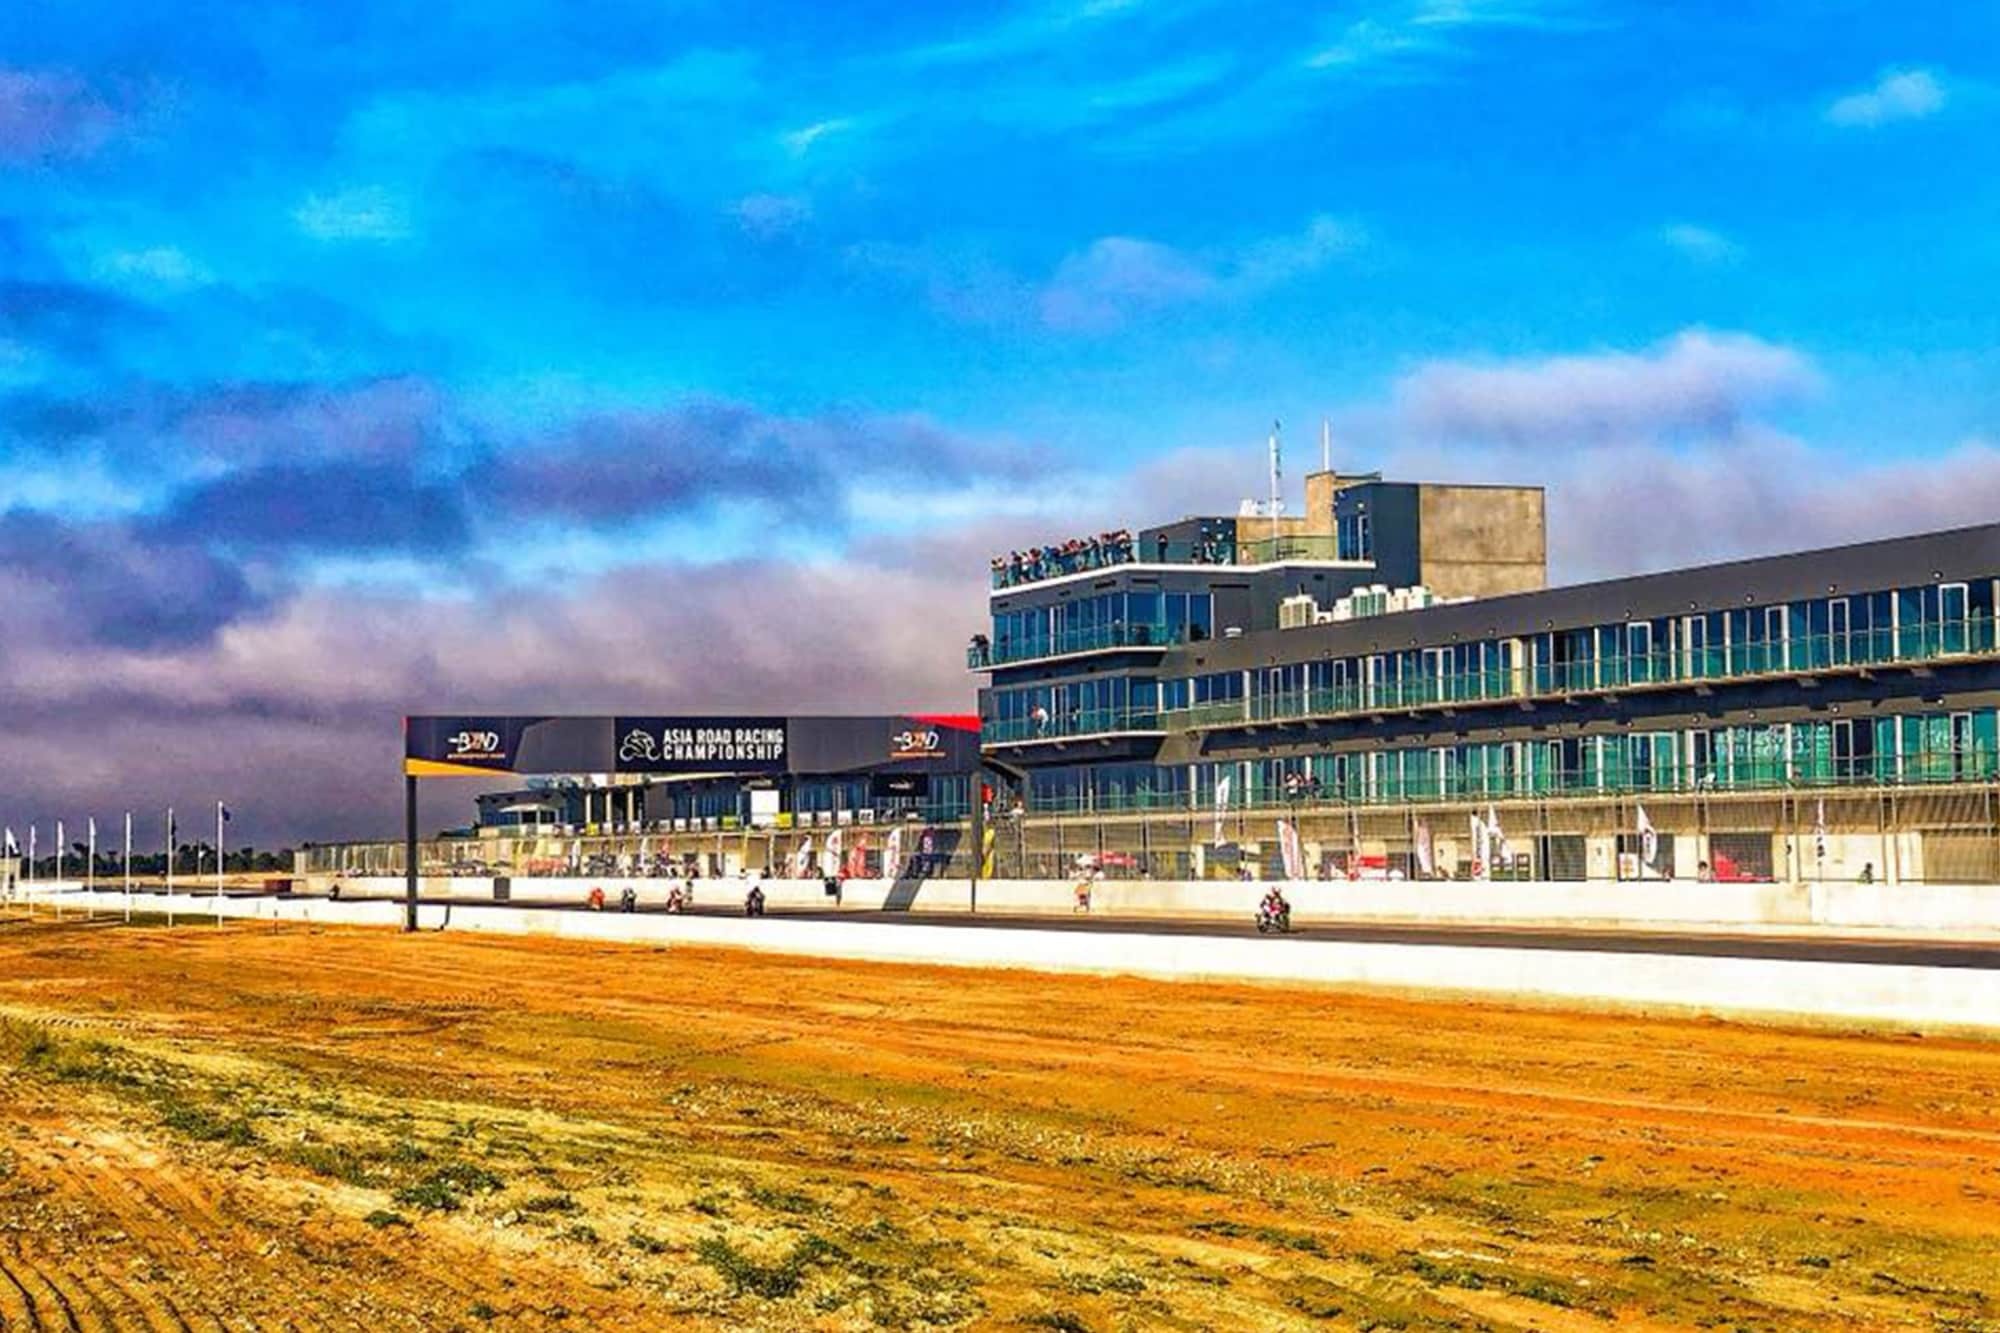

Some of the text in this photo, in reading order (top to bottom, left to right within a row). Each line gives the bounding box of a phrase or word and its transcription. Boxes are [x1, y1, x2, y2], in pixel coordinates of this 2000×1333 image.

[663, 729, 784, 744] ASIA ROAD RACING
[663, 745, 784, 760] CHAMPIONSHIP
